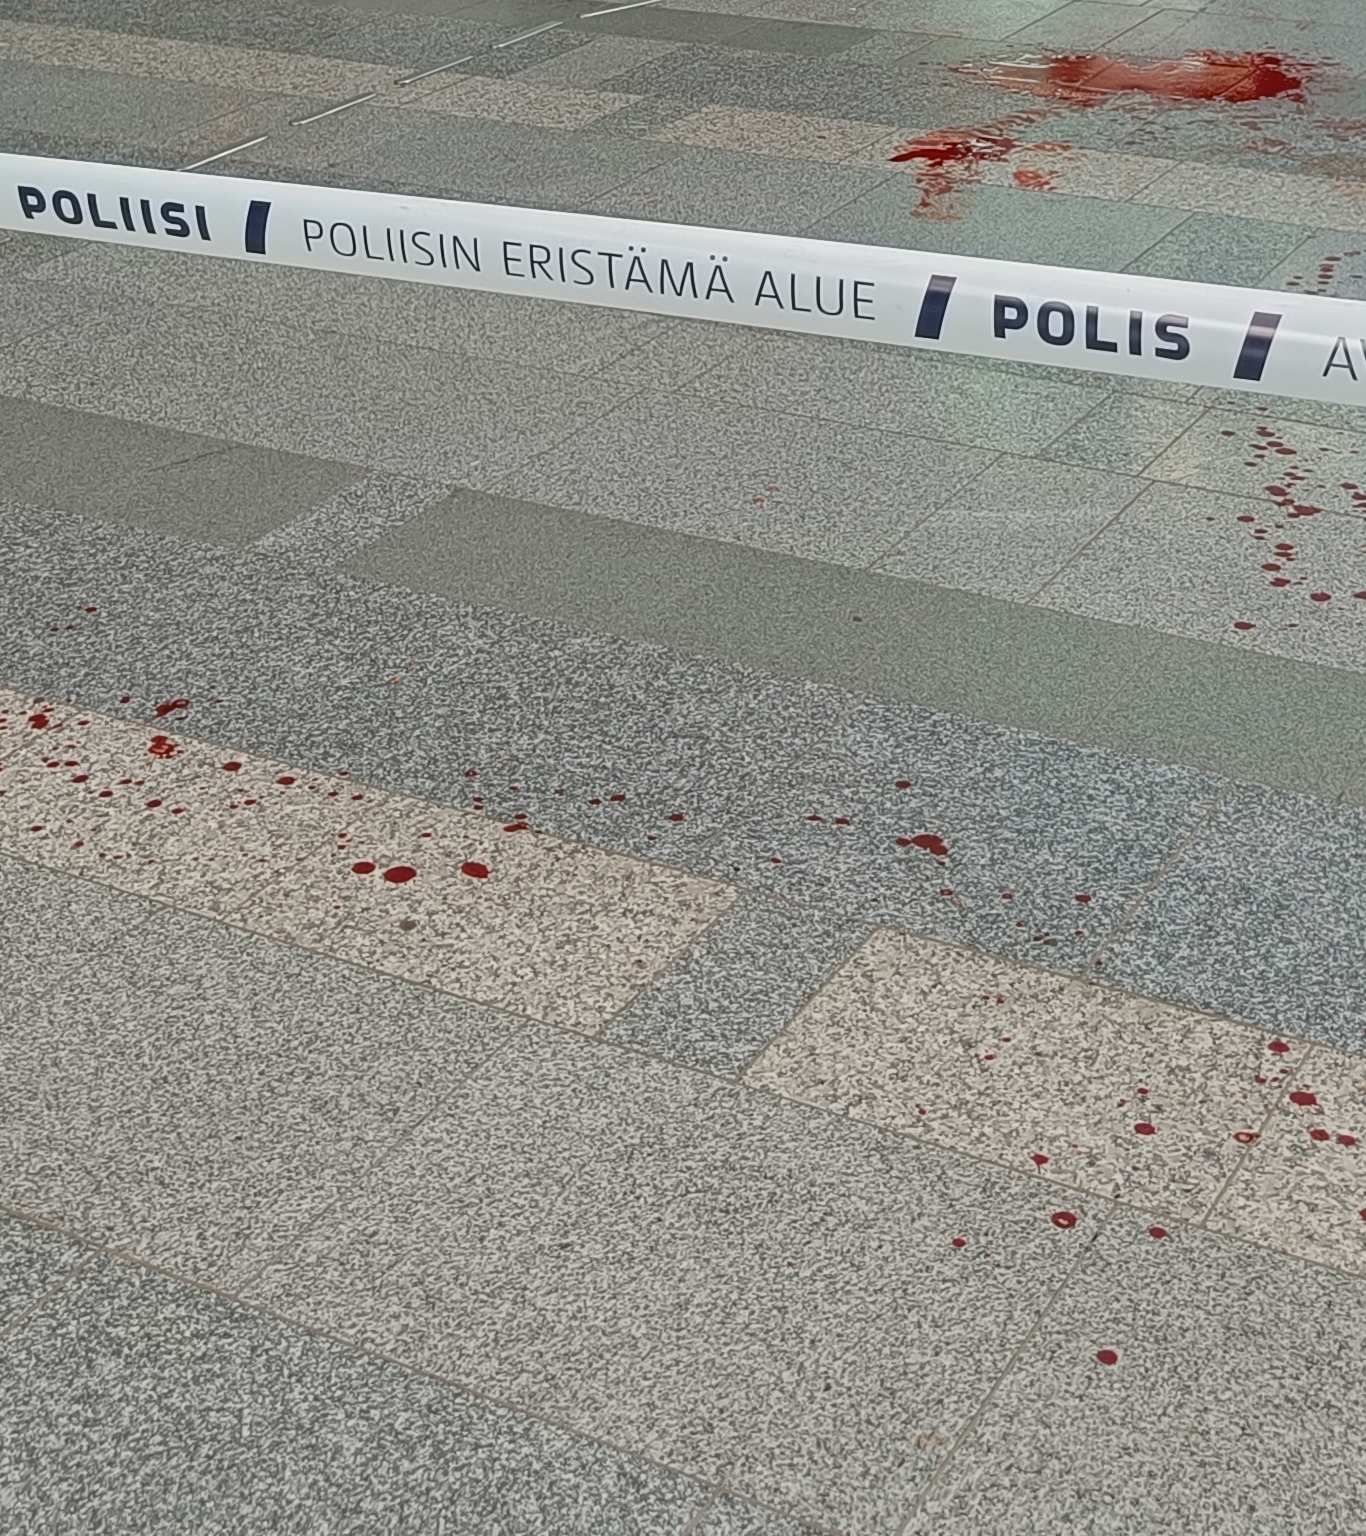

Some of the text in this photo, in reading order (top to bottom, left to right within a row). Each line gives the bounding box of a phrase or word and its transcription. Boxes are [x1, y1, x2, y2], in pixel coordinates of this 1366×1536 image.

[18, 185, 212, 241] POLIISI
[302, 218, 482, 272] POLIISIN
[502, 241, 734, 304] ERISTÄMÄ
[754, 270, 877, 322] ALUE
[992, 294, 1191, 361] POLIS
